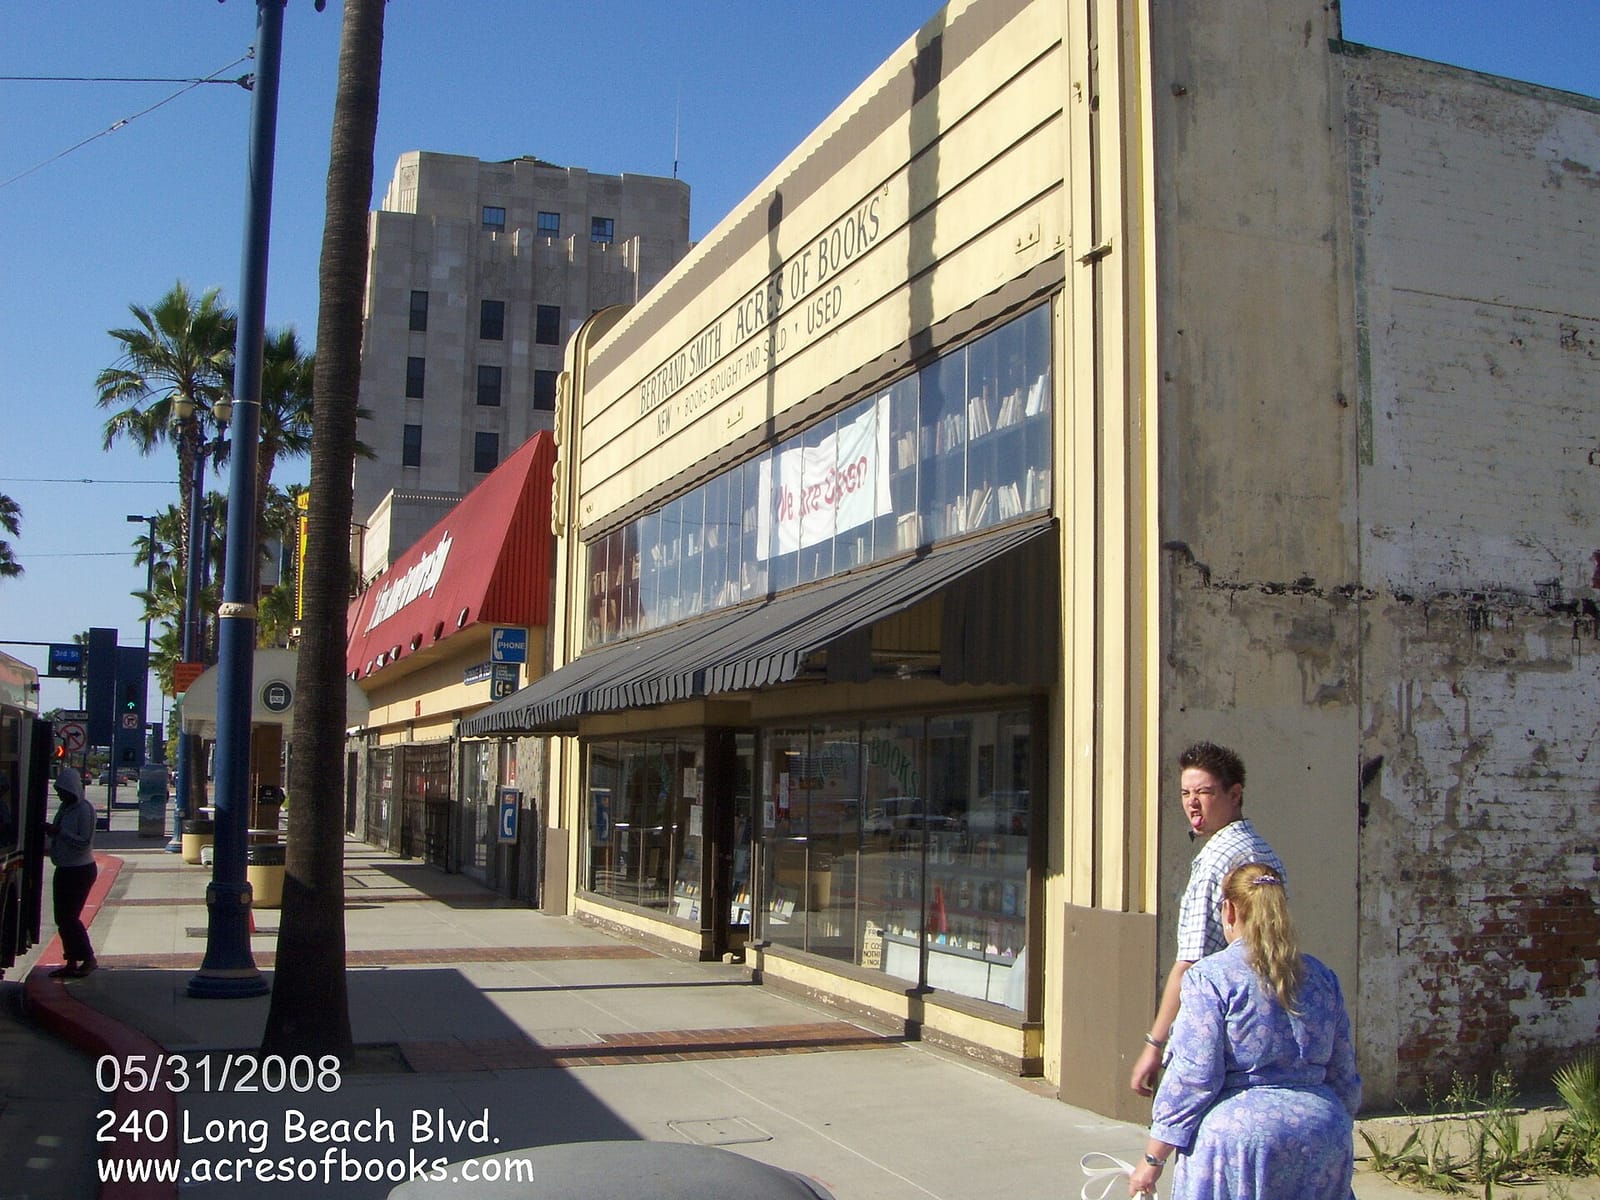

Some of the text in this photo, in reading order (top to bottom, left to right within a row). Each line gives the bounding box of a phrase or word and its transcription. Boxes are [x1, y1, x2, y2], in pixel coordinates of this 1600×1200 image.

[639, 195, 881, 414] BERTRAND SMITH ACRES OF BOOKS
[656, 284, 842, 439] NEW BOOKS BOUGHT AND SOLD USED
[498, 641, 527, 650] PHONE
